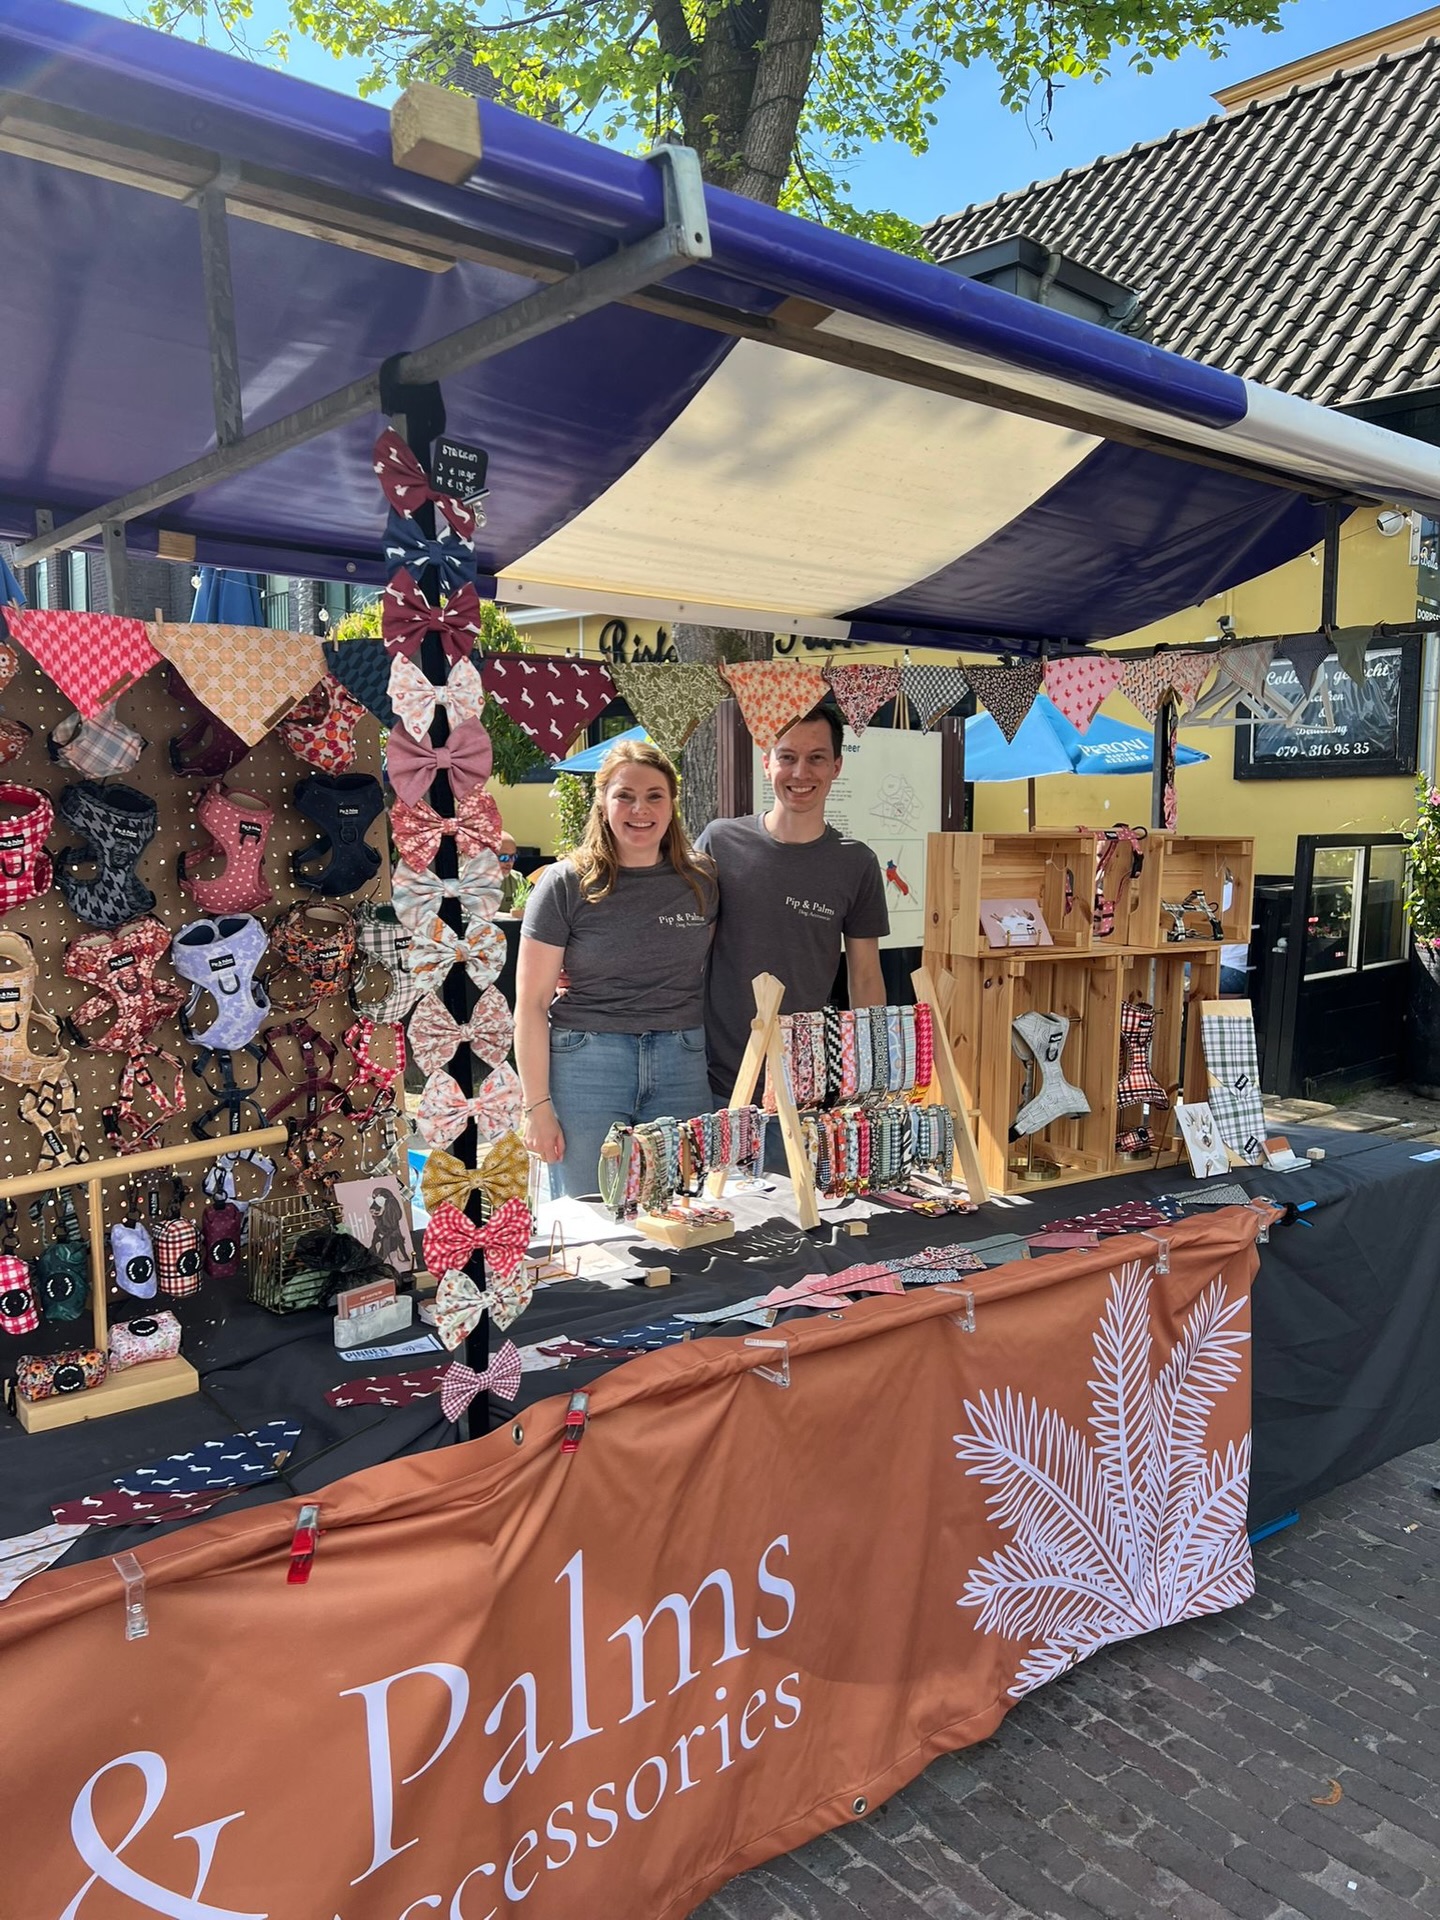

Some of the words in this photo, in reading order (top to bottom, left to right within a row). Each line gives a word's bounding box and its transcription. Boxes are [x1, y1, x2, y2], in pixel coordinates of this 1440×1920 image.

[1077, 738, 1149, 757] PERONI
[1275, 745, 1299, 757] 079
[1309, 744, 1331, 757] 316
[1334, 743, 1350, 755] 95
[1353, 742, 1370, 755] 35
[785, 896, 800, 909] Pip
[802, 899, 810, 909] &
[812, 902, 834, 916] Palms
[658, 915, 674, 926] Pip
[676, 913, 685, 922] &
[344, 1346, 389, 1359] PINNEN
[58, 1750, 268, 1920] &
[340, 1534, 797, 1885] Palms
